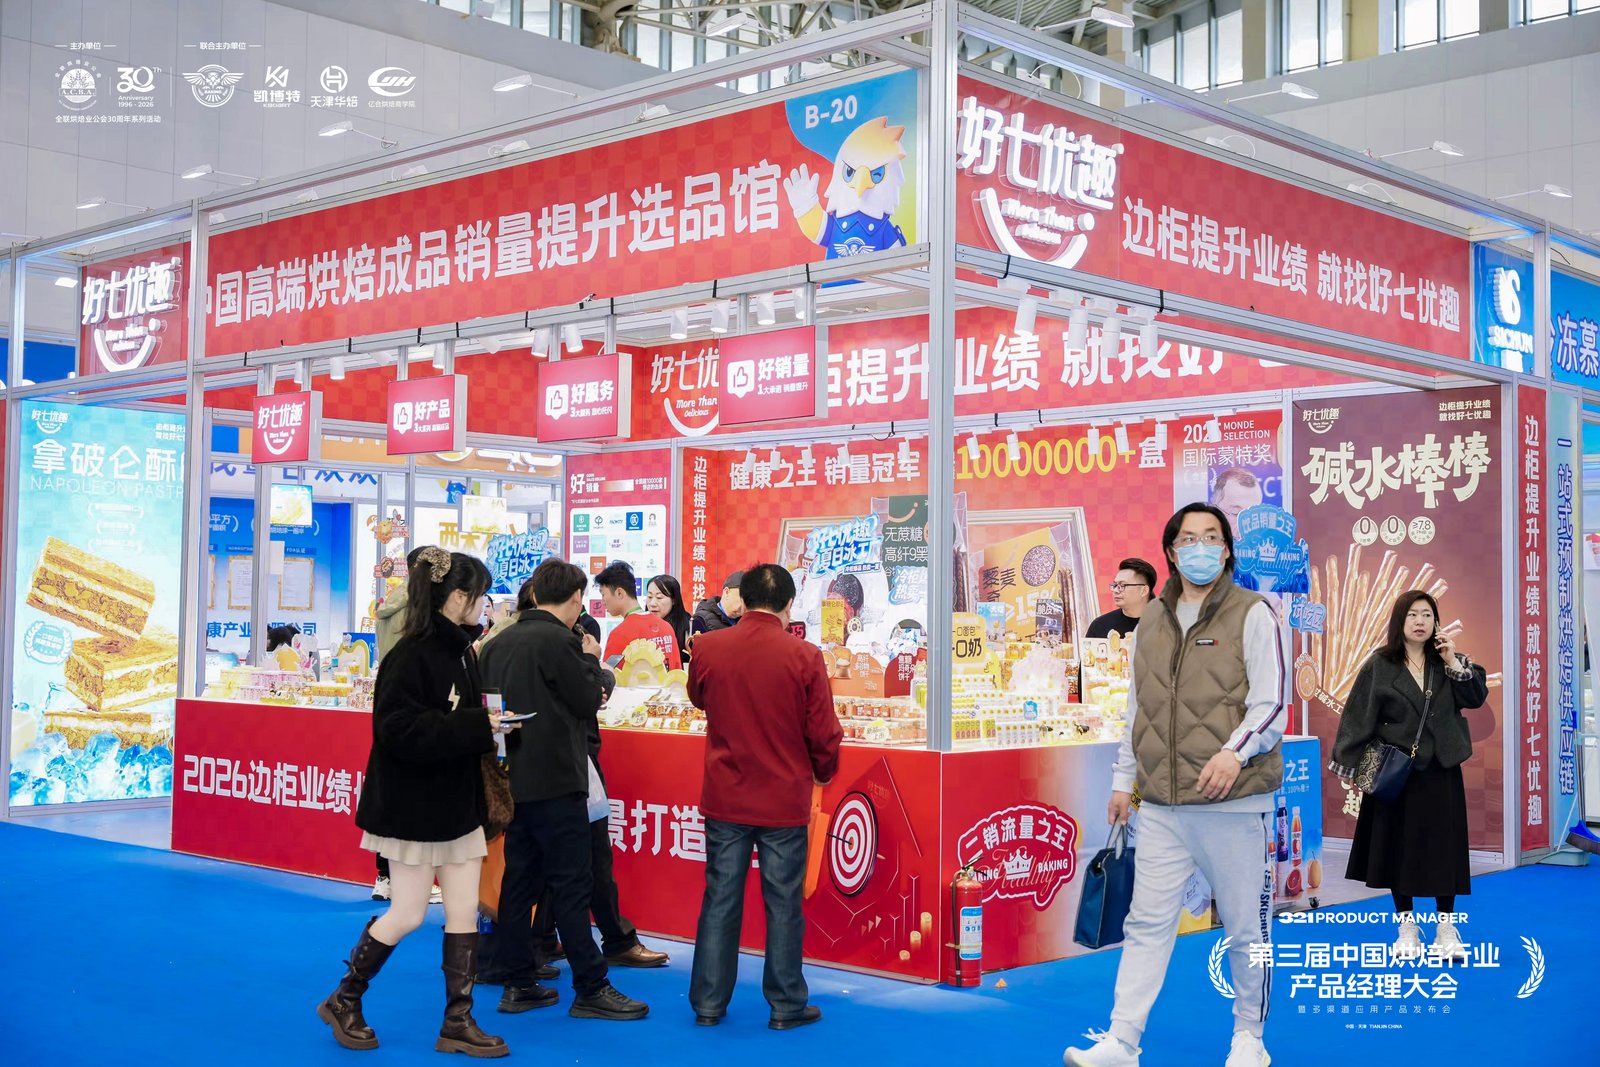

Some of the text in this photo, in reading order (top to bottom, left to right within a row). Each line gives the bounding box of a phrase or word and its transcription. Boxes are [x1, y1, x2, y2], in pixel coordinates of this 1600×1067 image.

[805, 96, 857, 129] B-20
[957, 96, 1124, 210] 好七优趣
[1122, 196, 1461, 332] 边柜提升业绩 就找好七优趣
[82, 257, 182, 324] 好七优趣
[757, 353, 810, 381] 好销量
[570, 380, 614, 405] 好服务
[31, 409, 70, 424] 好七优趣
[257, 401, 305, 429] 好七优趣
[414, 399, 450, 422] 好产品
[1302, 408, 1340, 422] 好七优趣
[1439, 399, 1491, 412] 边柜提升业绩
[1439, 410, 1492, 422] 就找好七优趣
[1223, 429, 1271, 441] SELECTION
[1224, 419, 1255, 431] MONDE
[32, 438, 185, 482] 拿破仑酥
[1183, 443, 1271, 468] 国际蒙特奖
[730, 450, 921, 491] 健康之王 销量冠军
[1301, 431, 1491, 509] 碱水棒棒
[30, 475, 128, 497] NAPOLEON
[571, 473, 585, 495] 好
[586, 483, 599, 493] 销量
[692, 456, 707, 562] 边柜提升业绩
[885, 526, 923, 542] 无蔗糖
[1360, 517, 1370, 534] 0
[1388, 516, 1399, 533] 0
[818, 539, 882, 571] 夏日冰工厂
[885, 546, 928, 562] 高纤9黑
[1524, 414, 1542, 827] 边柜提升业绩 就找好七优趣
[1557, 437, 1574, 797] 一站式预制烘焙供应链
[952, 639, 982, 658] 口奶
[1282, 758, 1310, 782] 之王
[965, 814, 1068, 863] 二销流量之王
[971, 858, 1068, 883] AKING BAKING
[1260, 893, 1271, 944] SKECHERS
